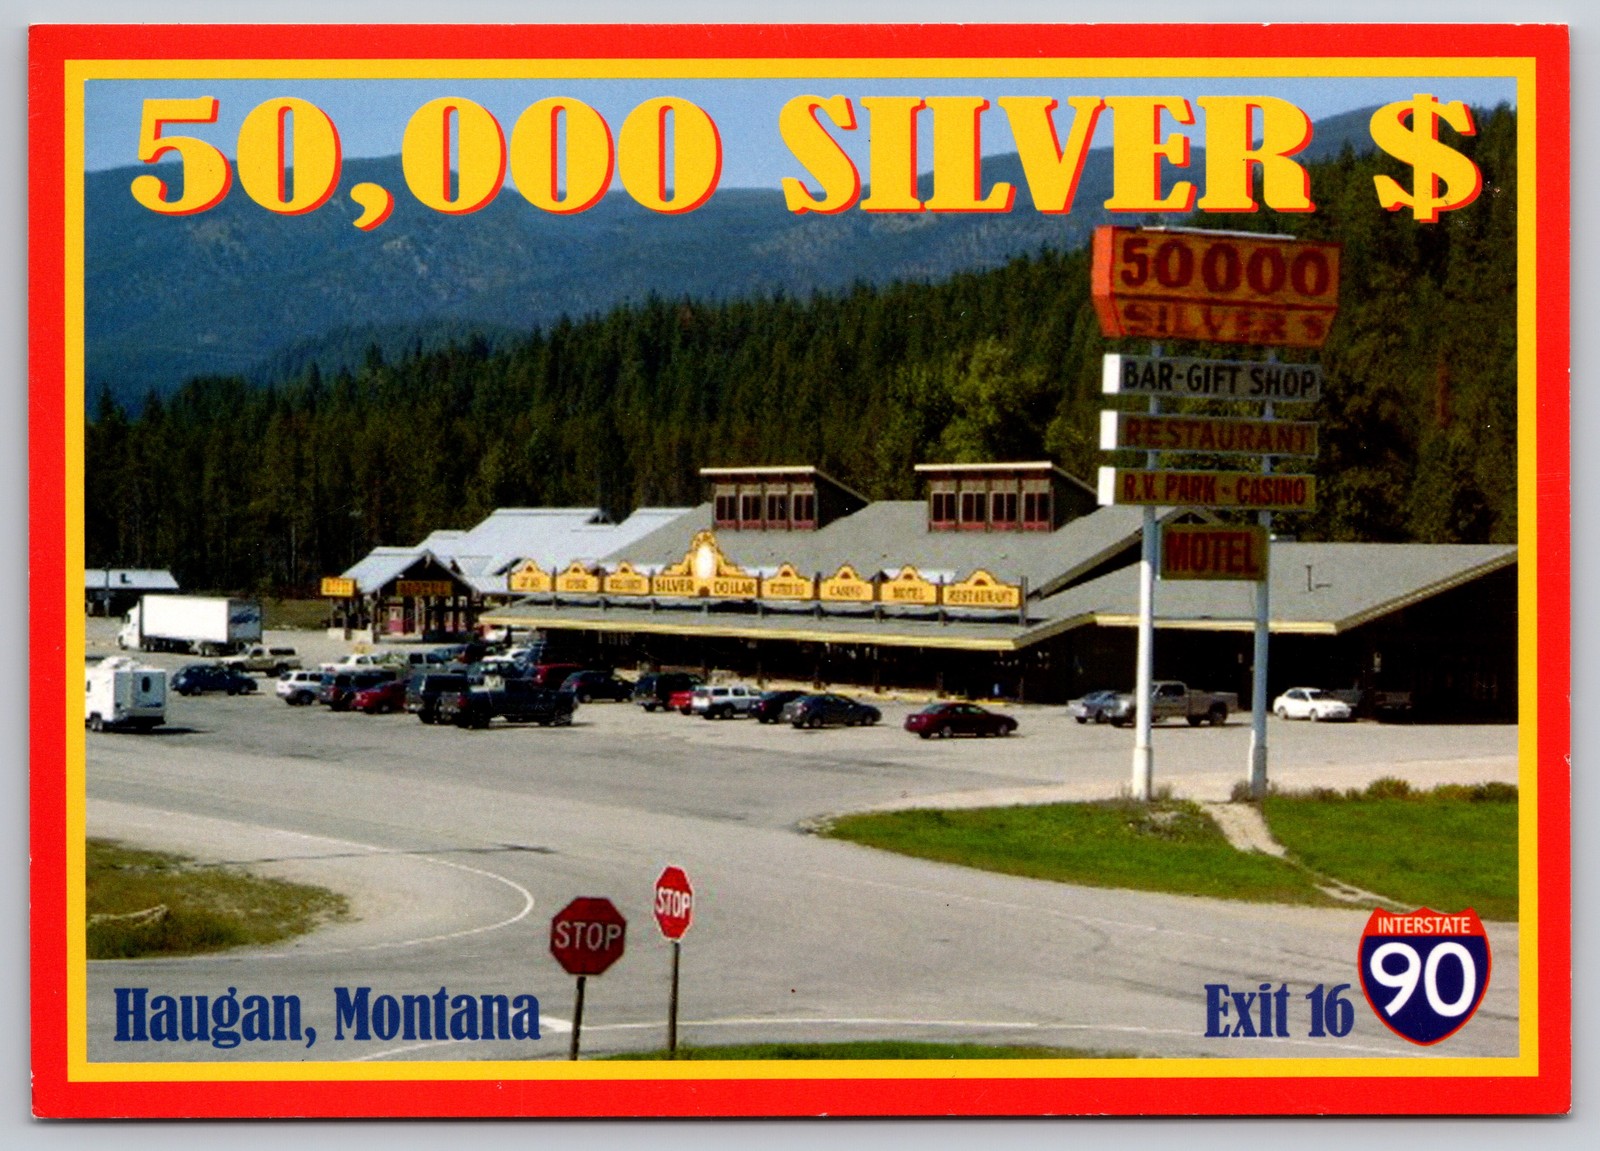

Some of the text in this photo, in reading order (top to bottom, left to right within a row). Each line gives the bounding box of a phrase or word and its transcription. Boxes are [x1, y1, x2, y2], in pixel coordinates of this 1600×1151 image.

[1121, 237, 1330, 297] 50000
[1123, 302, 1287, 341] SILVER
[1250, 367, 1315, 397] SHOP
[1125, 417, 1311, 452] RESTAURANT
[1166, 474, 1217, 504] PARK
[1236, 476, 1307, 506] CASINO
[1166, 530, 1260, 573] MOTEL
[655, 578, 694, 593] SILVER
[714, 581, 754, 595] DOLLAR
[653, 886, 691, 919] STOP
[554, 920, 622, 951] STOP
